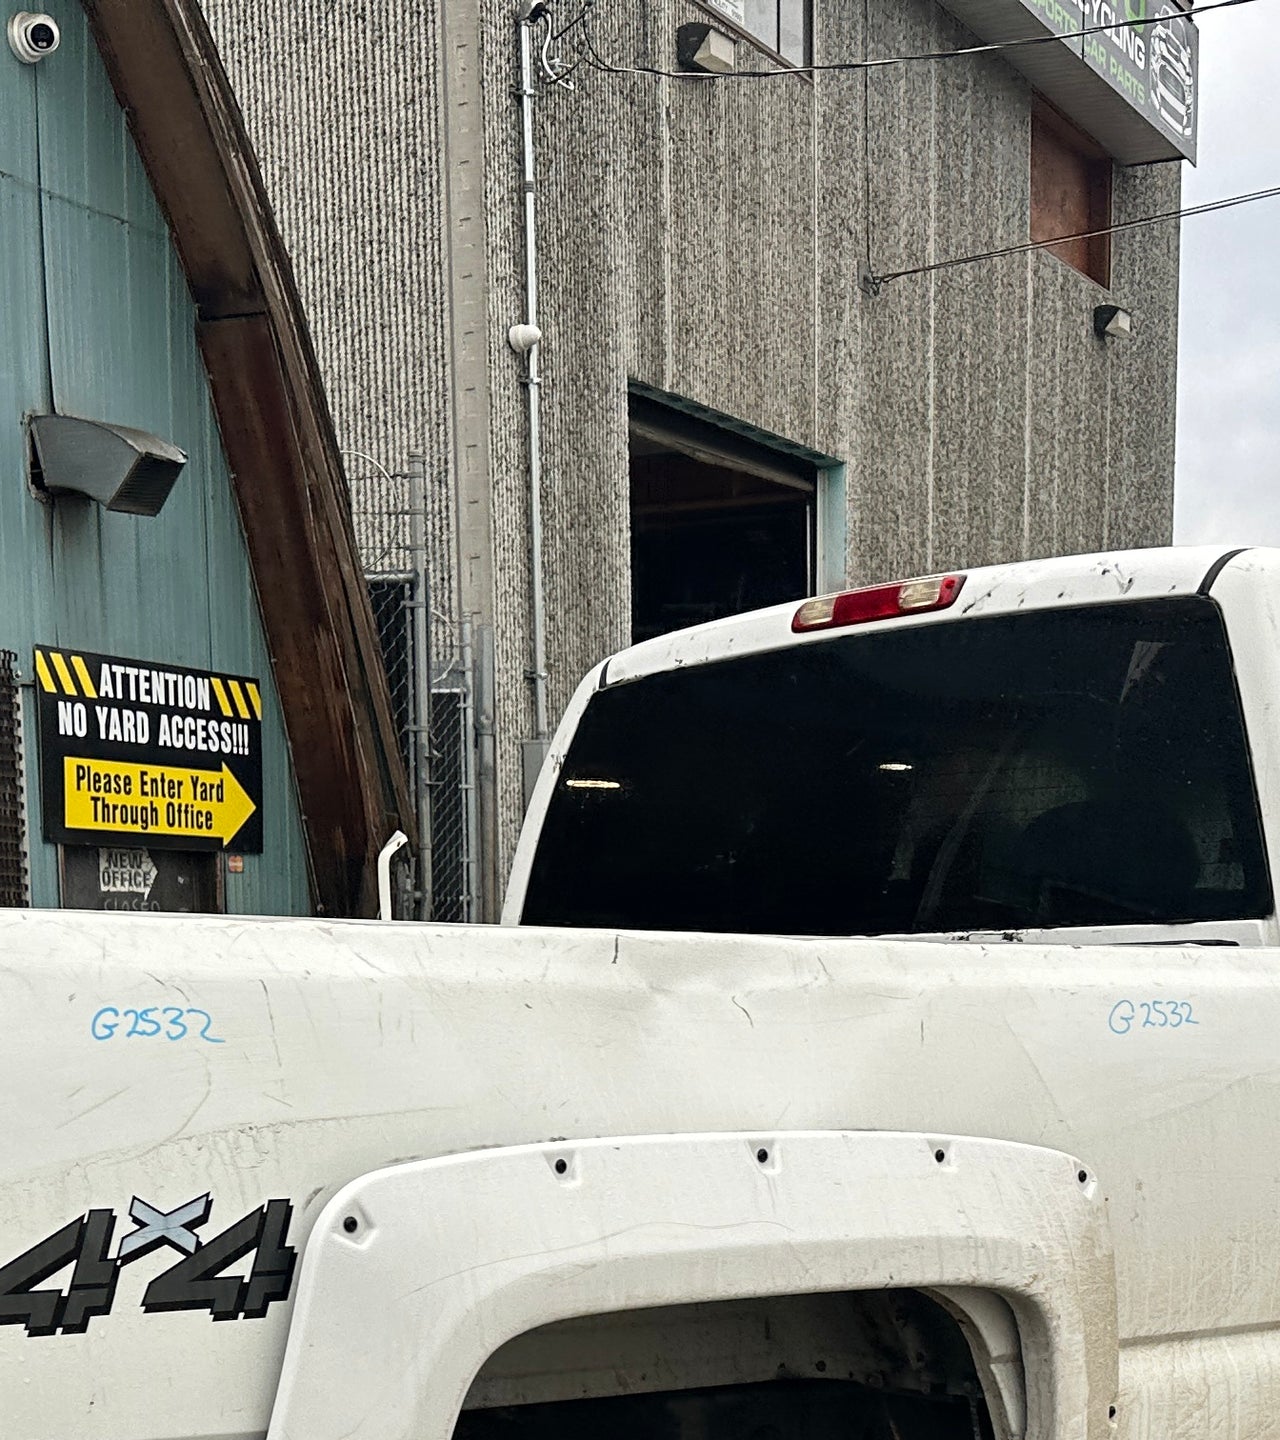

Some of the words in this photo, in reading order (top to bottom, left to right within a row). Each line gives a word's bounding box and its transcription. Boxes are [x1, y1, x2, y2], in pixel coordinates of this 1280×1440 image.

[1071, 0, 1145, 70] YCLING
[1110, 55, 1145, 105] PARTS
[99, 663, 210, 711] ATTENTION
[58, 700, 87, 738] NO
[95, 705, 150, 745] YARD
[158, 714, 250, 756] ACCESS!!!
[76, 764, 132, 796] Please
[140, 770, 184, 799] Enter
[190, 776, 225, 803] Yard
[90, 796, 159, 831] Through
[166, 801, 213, 830] Office
[102, 869, 151, 888] OFFICE
[107, 850, 143, 869] NEW
[91, 1006, 226, 1043] G2532
[1108, 999, 1200, 1034] G2532
